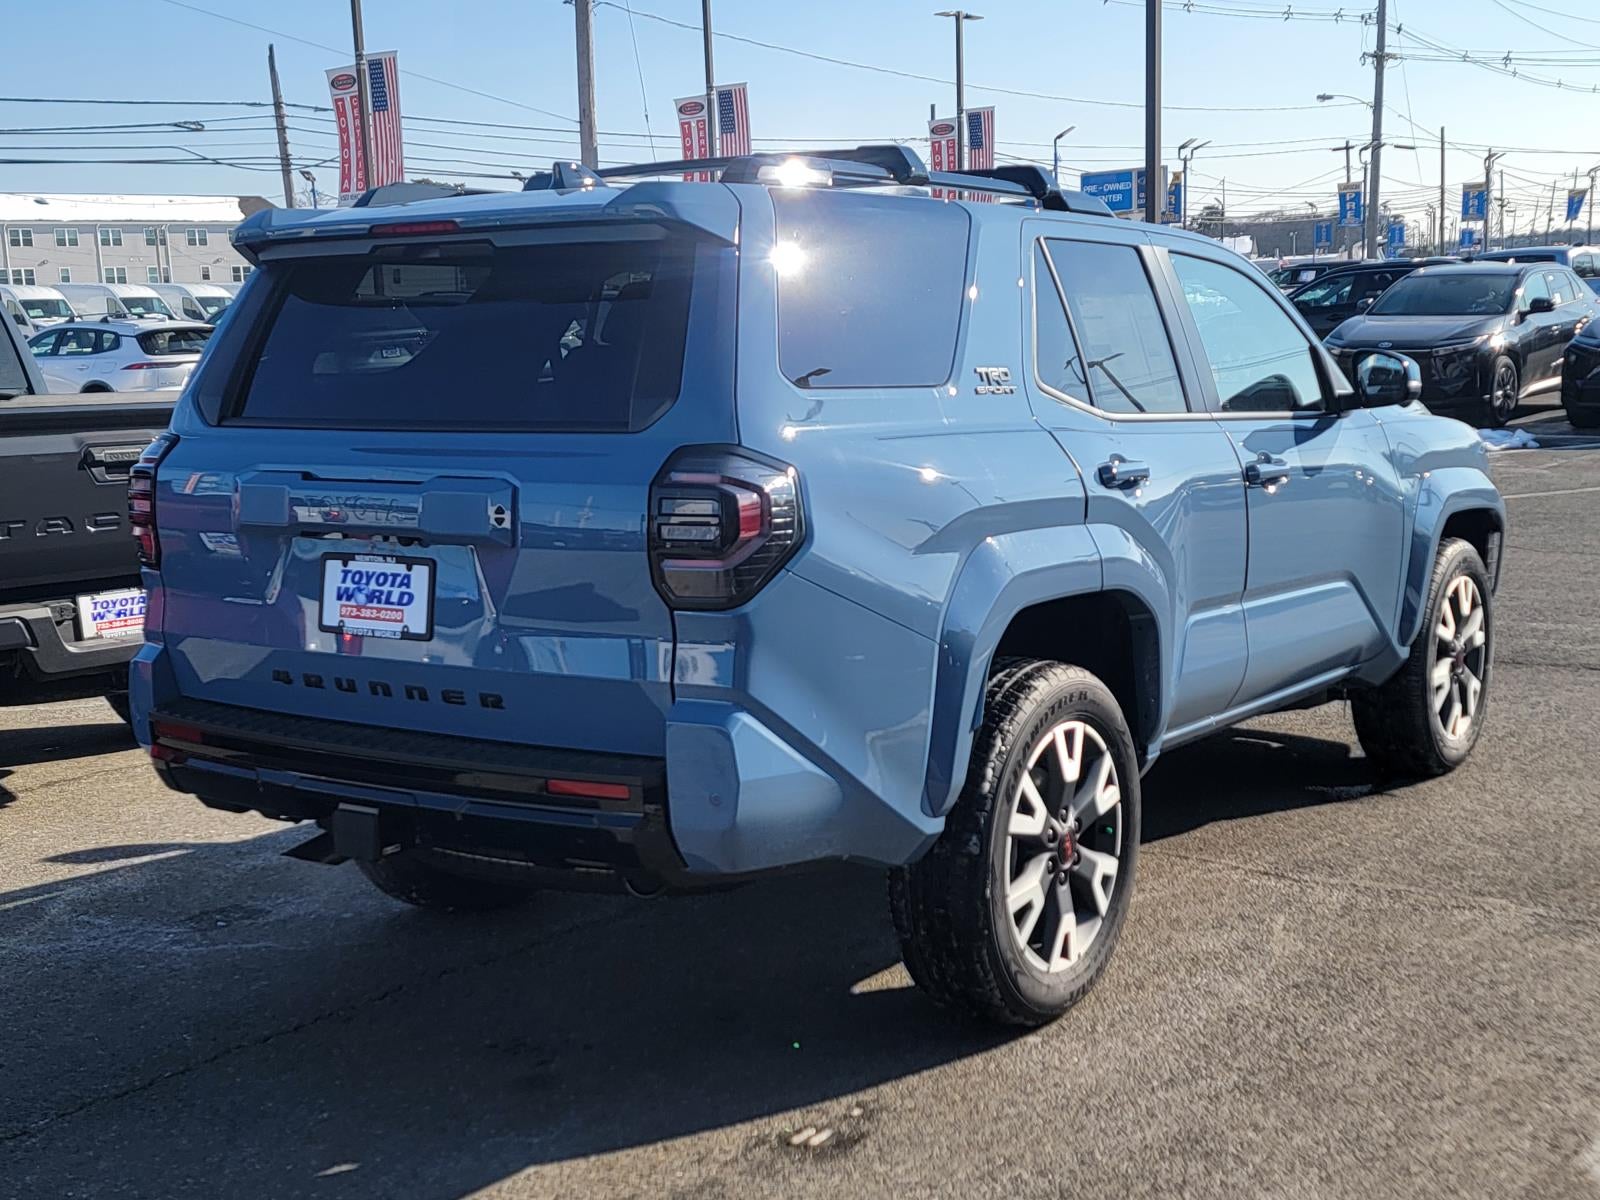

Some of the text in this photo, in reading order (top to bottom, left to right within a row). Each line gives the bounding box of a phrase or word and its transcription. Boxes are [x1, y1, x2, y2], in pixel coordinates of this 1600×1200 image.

[338, 101, 351, 192] TOYOTA
[352, 98, 364, 189] CERTIFIED
[974, 367, 1010, 386] TRD
[975, 385, 1017, 395] SPORT
[341, 569, 412, 589] TOYOTA
[91, 595, 147, 611] TOYOTA
[336, 585, 415, 607] WORLD
[272, 669, 506, 709] 4RUNNER
